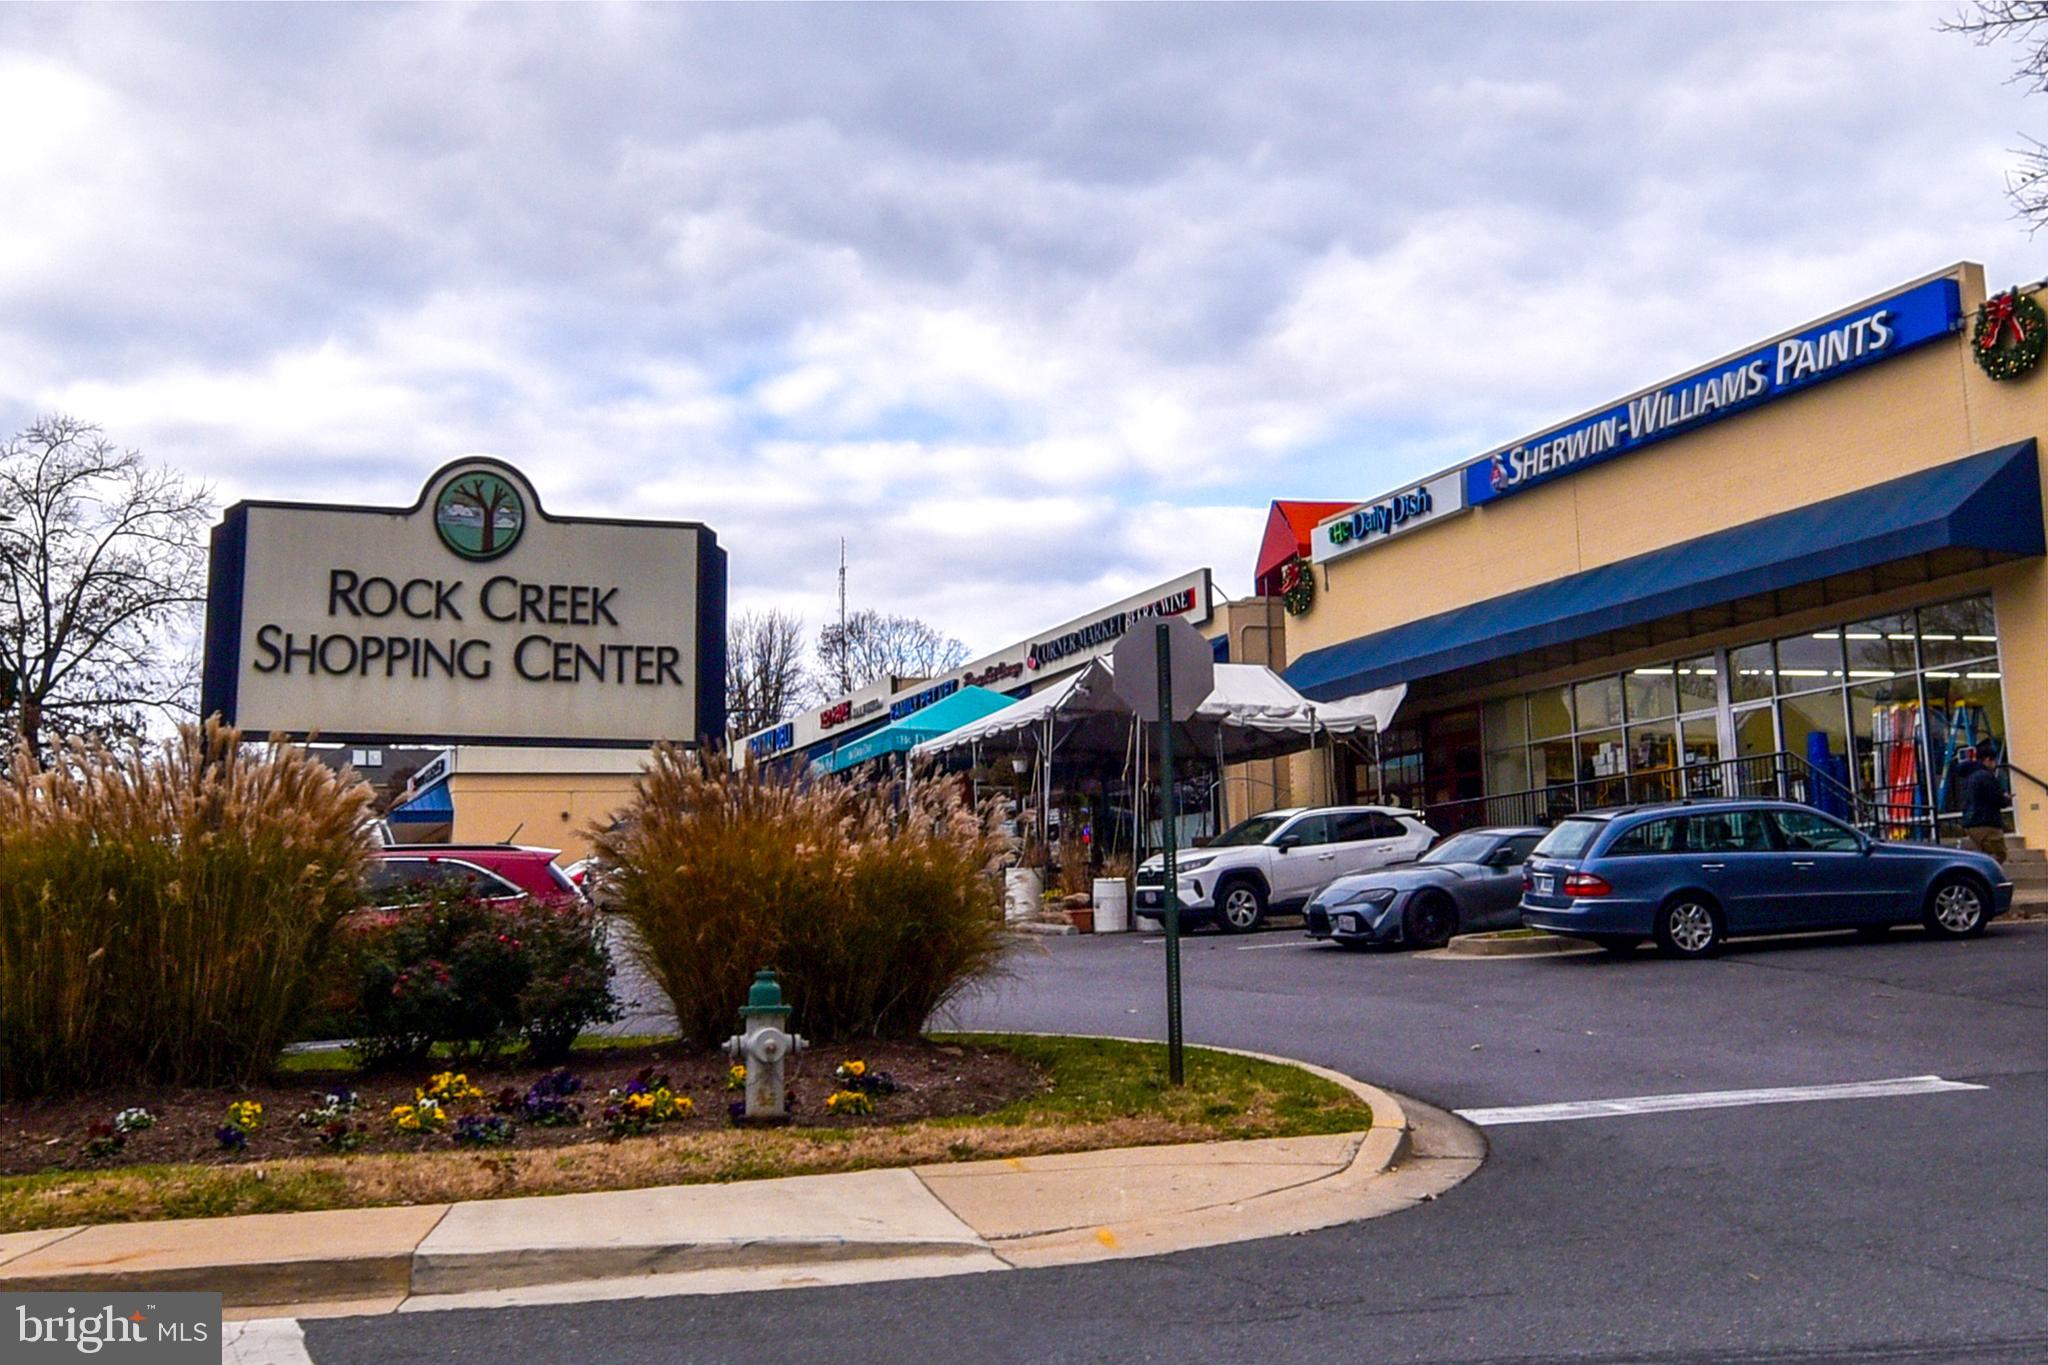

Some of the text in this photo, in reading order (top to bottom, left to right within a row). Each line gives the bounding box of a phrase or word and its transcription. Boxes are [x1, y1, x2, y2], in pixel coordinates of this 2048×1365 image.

[1507, 310, 1890, 485] SHERWIN-WILLIAMS PAINTS
[1352, 505, 1392, 538] Daily
[1392, 487, 1431, 526] Dish
[328, 568, 619, 627] ROCK CREEK
[1036, 631, 1079, 666] CORNER
[1078, 612, 1125, 649] MARKET
[1160, 590, 1189, 615] WINE
[253, 624, 683, 686] SHOPPING CENTER
